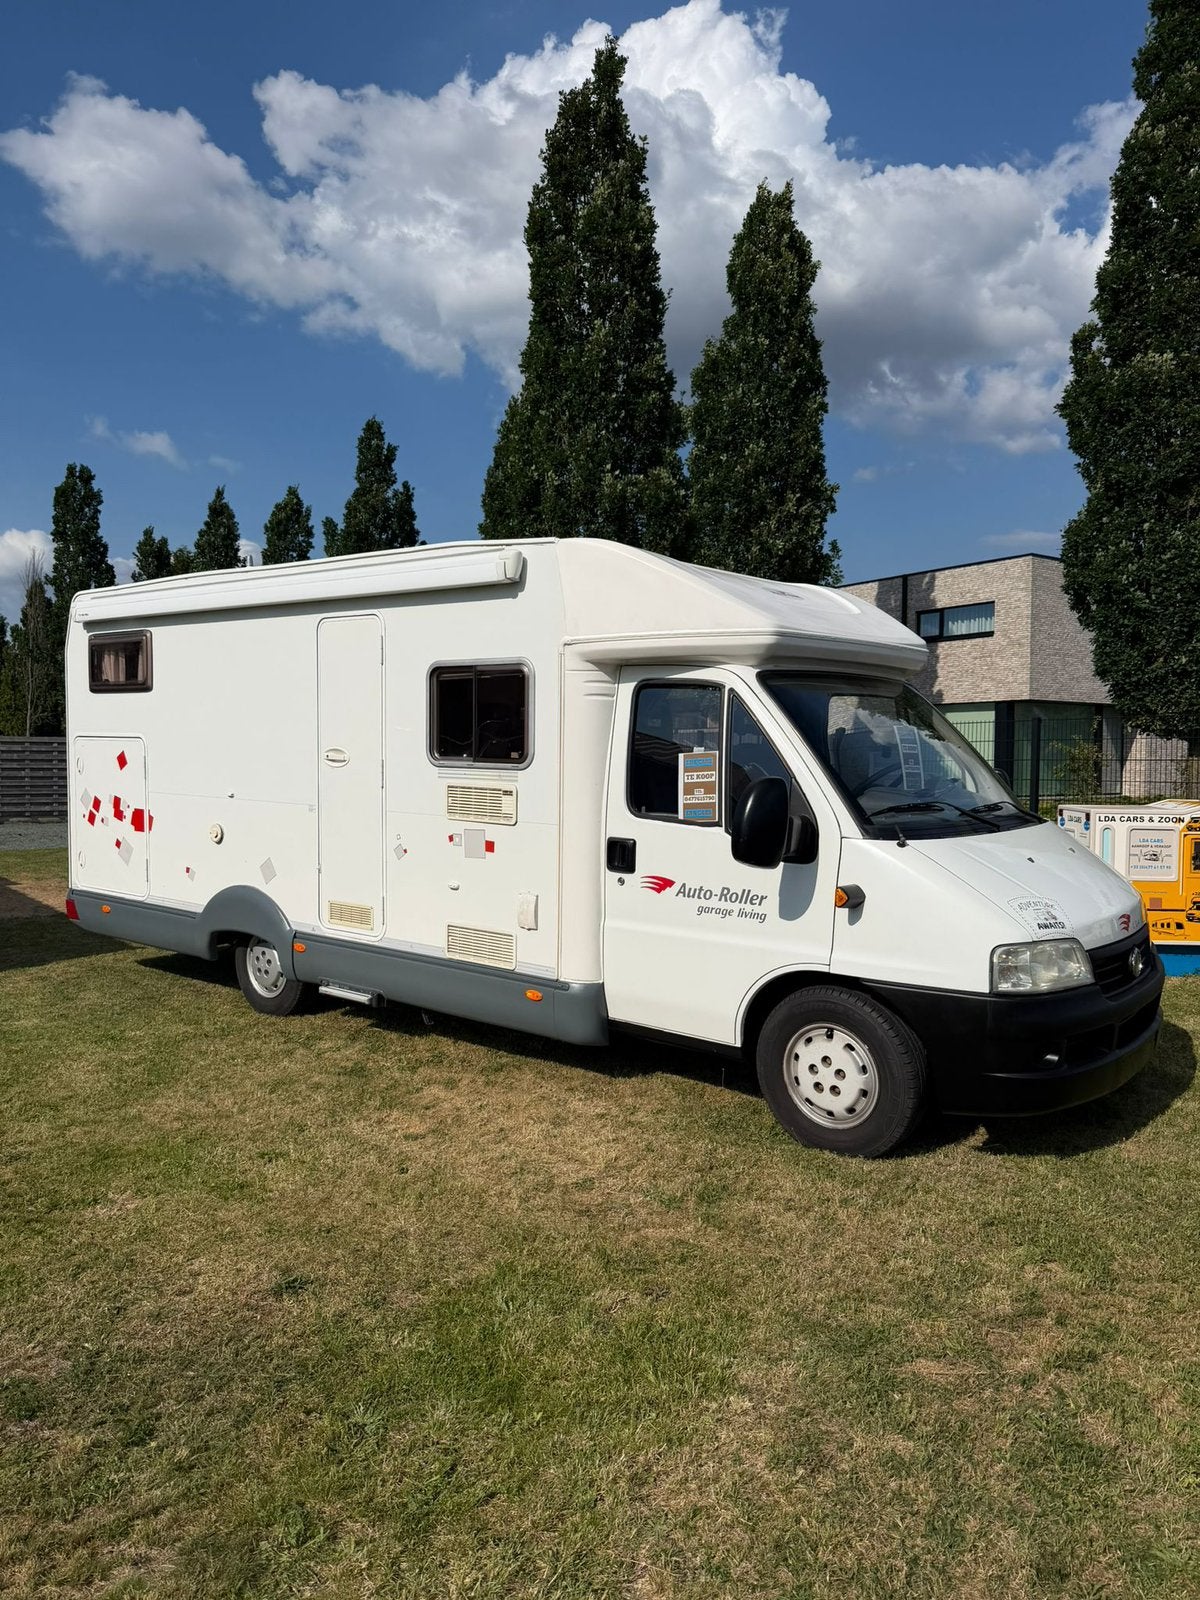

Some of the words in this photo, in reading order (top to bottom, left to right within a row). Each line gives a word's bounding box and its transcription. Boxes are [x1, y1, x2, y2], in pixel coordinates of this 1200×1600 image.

[696, 772, 715, 780] KOOP
[1098, 815, 1117, 823] LDA
[1119, 815, 1145, 823] CARS
[1157, 816, 1186, 824] ZOON
[675, 882, 768, 907] Auto-Roller
[696, 905, 735, 919] garage
[737, 907, 767, 924] living
